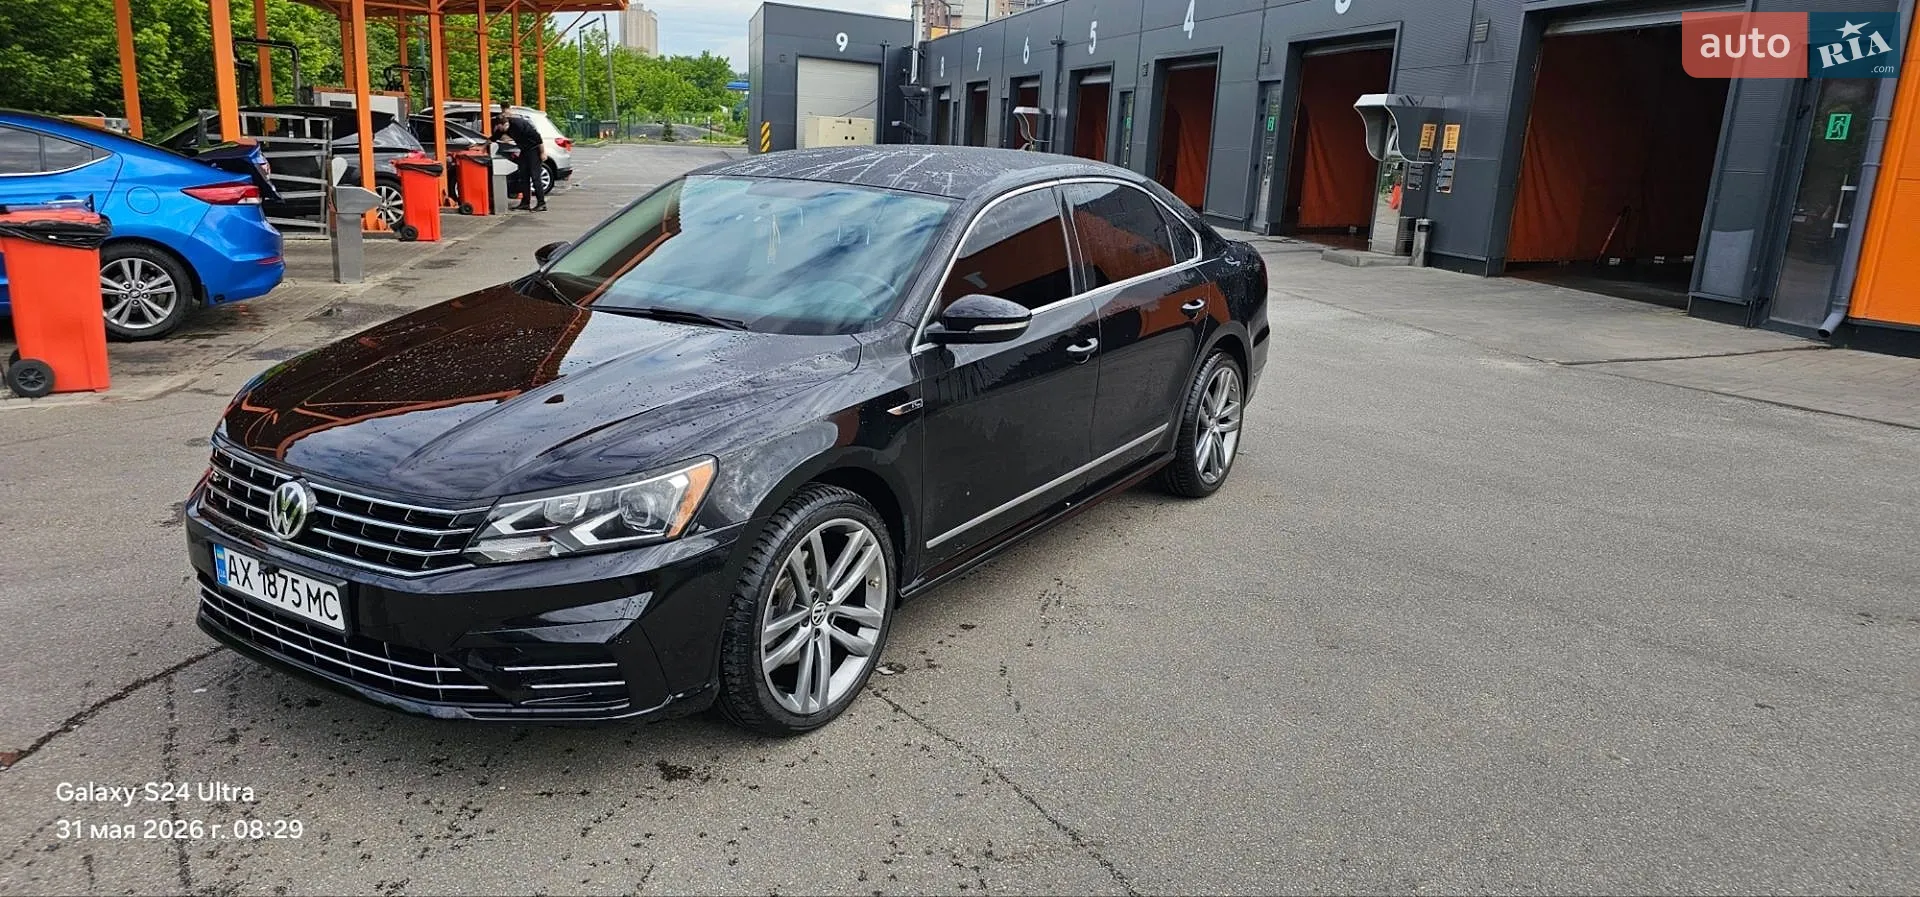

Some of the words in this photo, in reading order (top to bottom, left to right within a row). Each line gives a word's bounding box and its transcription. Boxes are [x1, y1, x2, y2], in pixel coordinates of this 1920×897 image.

[1088, 20, 1098, 55] 5
[1183, 0, 1195, 40] 4
[836, 32, 848, 52] 9
[1023, 36, 1030, 65] 6
[228, 555, 254, 590] AX
[258, 568, 302, 608] 1875
[306, 583, 338, 620] MC
